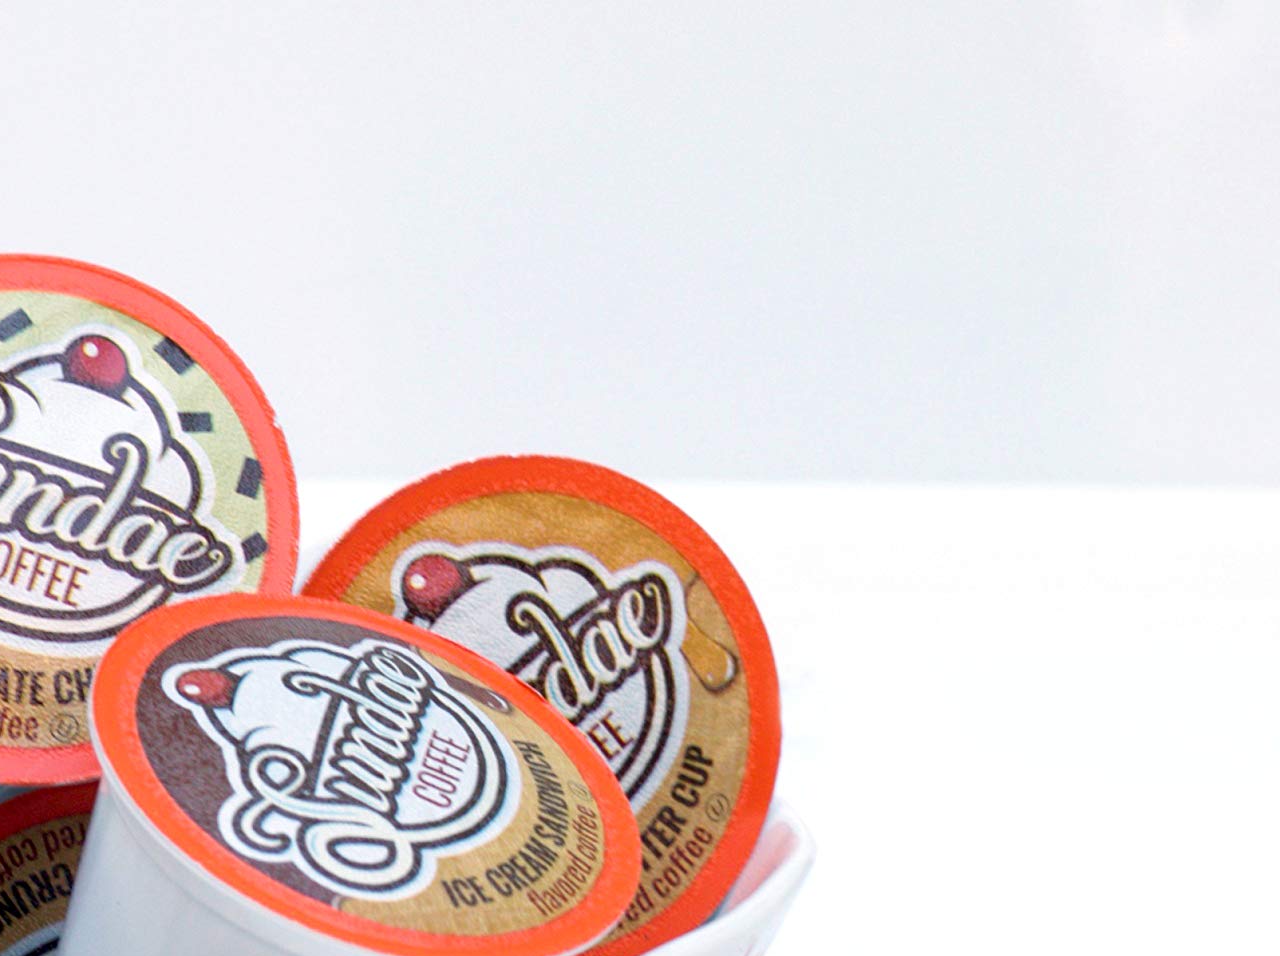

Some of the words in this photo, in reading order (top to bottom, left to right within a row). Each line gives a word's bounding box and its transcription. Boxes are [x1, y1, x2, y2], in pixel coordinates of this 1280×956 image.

[506, 574, 671, 722] dae
[233, 645, 435, 893] Sundae
[412, 729, 472, 809] COFFEE
[513, 738, 570, 848] SANDWICH
[670, 743, 716, 806] CUP
[440, 876, 496, 909] ICE
[484, 835, 560, 897] CREAM
[526, 850, 593, 917] flavored
[572, 803, 600, 863] coffee
[651, 822, 715, 900] coffee
